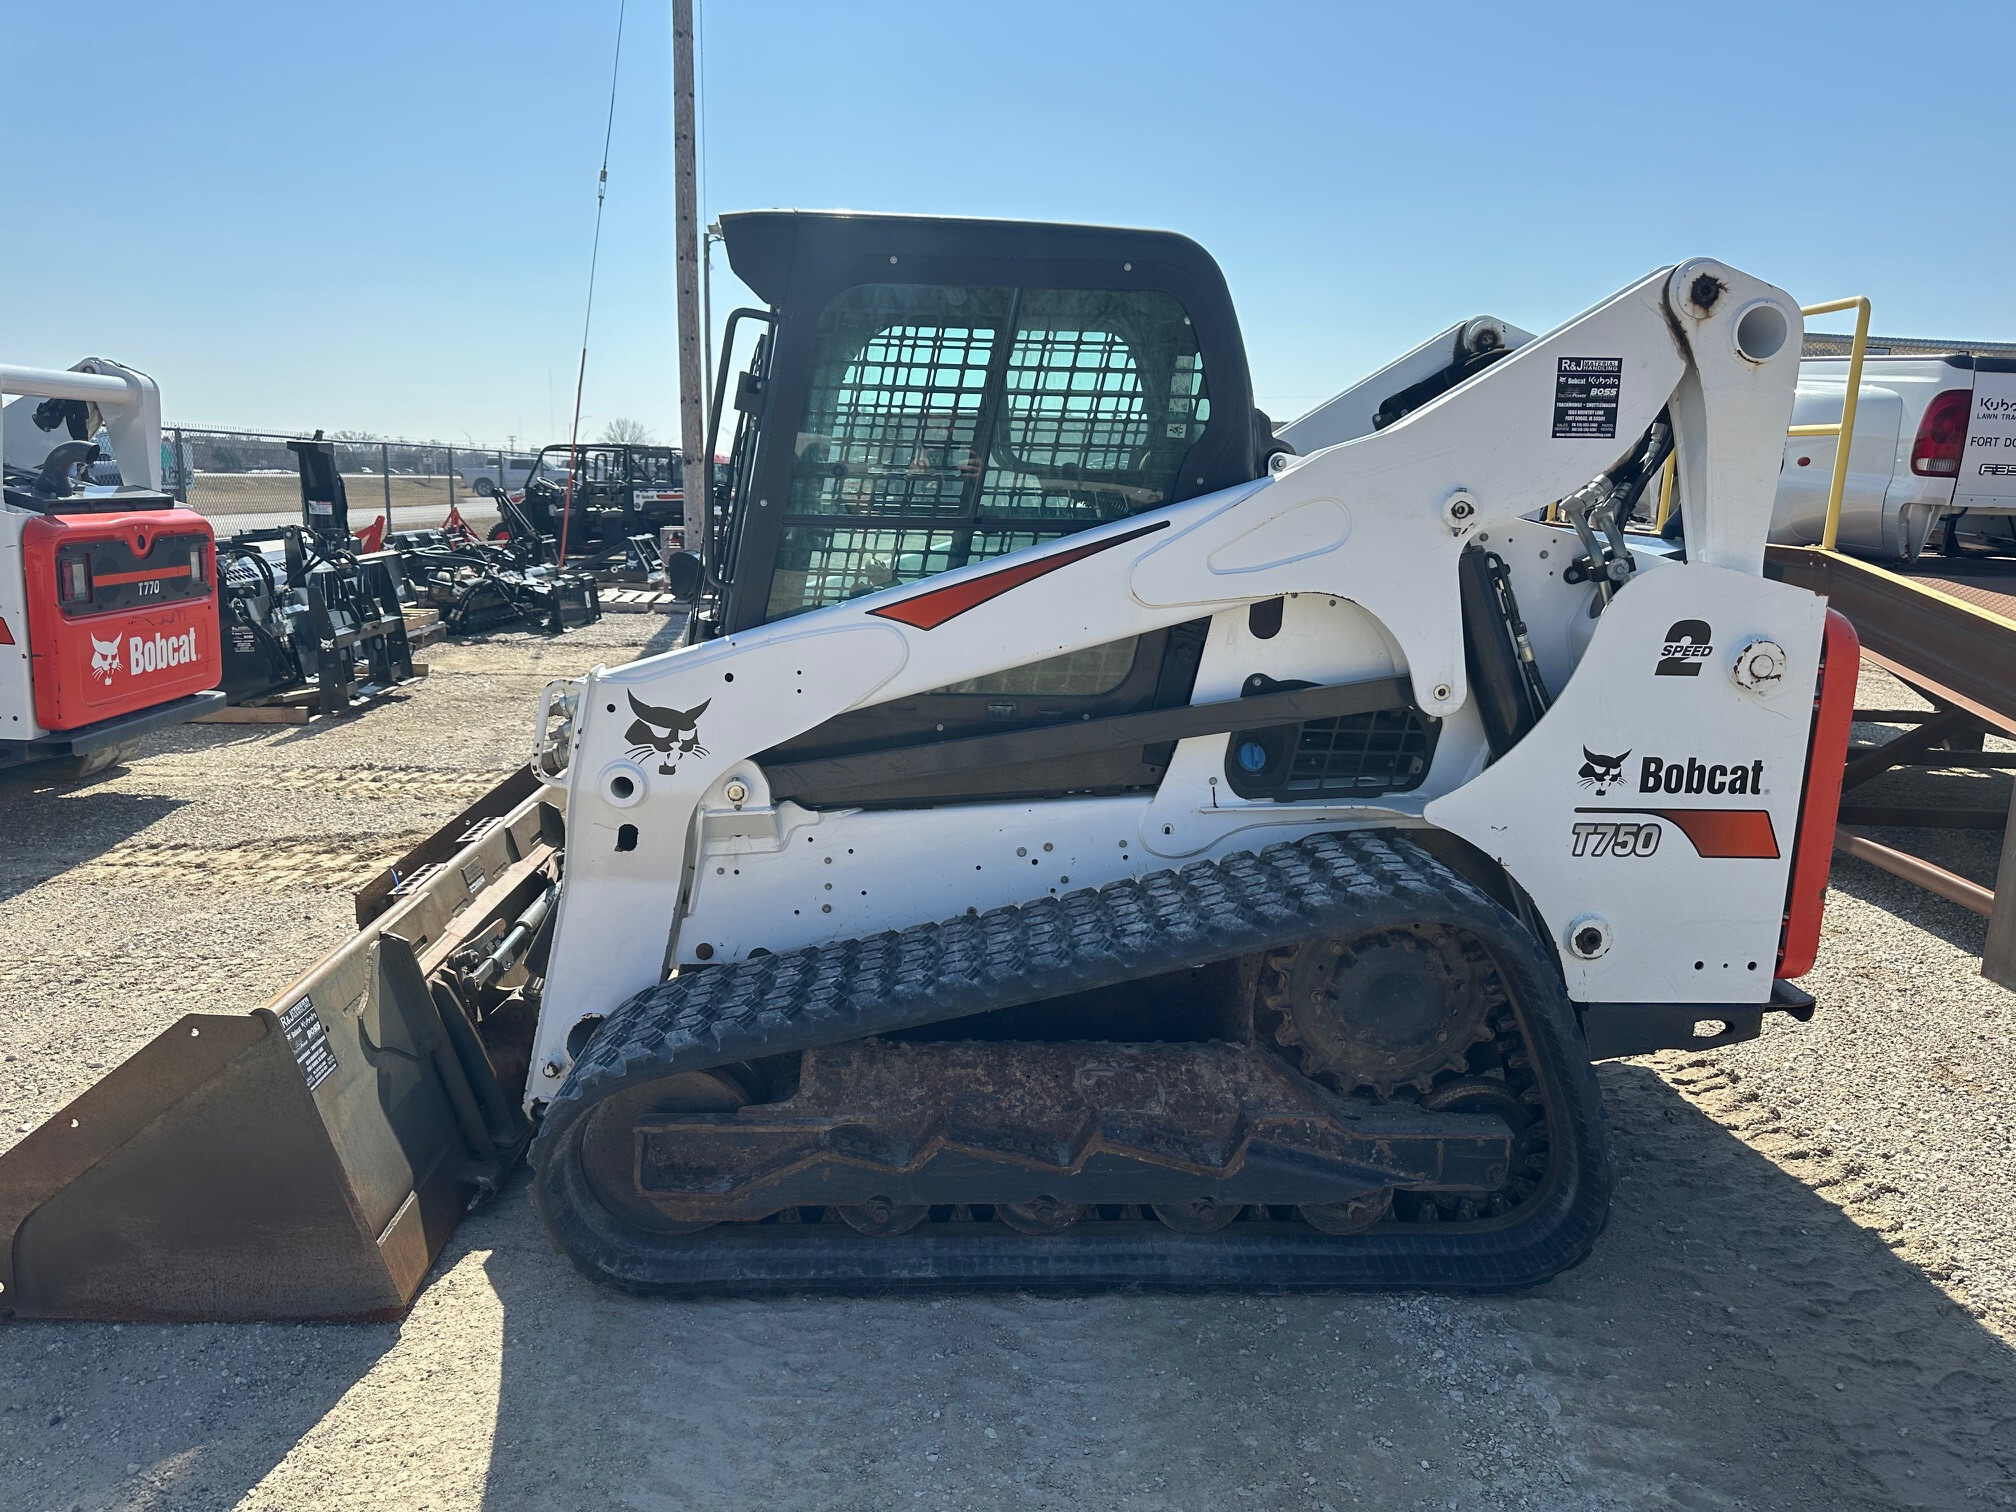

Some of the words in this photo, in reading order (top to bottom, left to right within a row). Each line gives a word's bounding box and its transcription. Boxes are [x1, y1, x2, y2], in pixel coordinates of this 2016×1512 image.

[1561, 359, 1583, 371] R&J
[1568, 377, 1586, 385] Bobcat
[1588, 376, 1619, 385] Kubota
[1590, 387, 1618, 396] BOSS
[1970, 436, 2000, 447] FORT
[137, 580, 160, 597] T770
[129, 627, 197, 676] Bobcat
[1661, 644, 1713, 657] SPEED
[1638, 756, 1763, 795] Bobcat
[1571, 822, 1662, 857] T750
